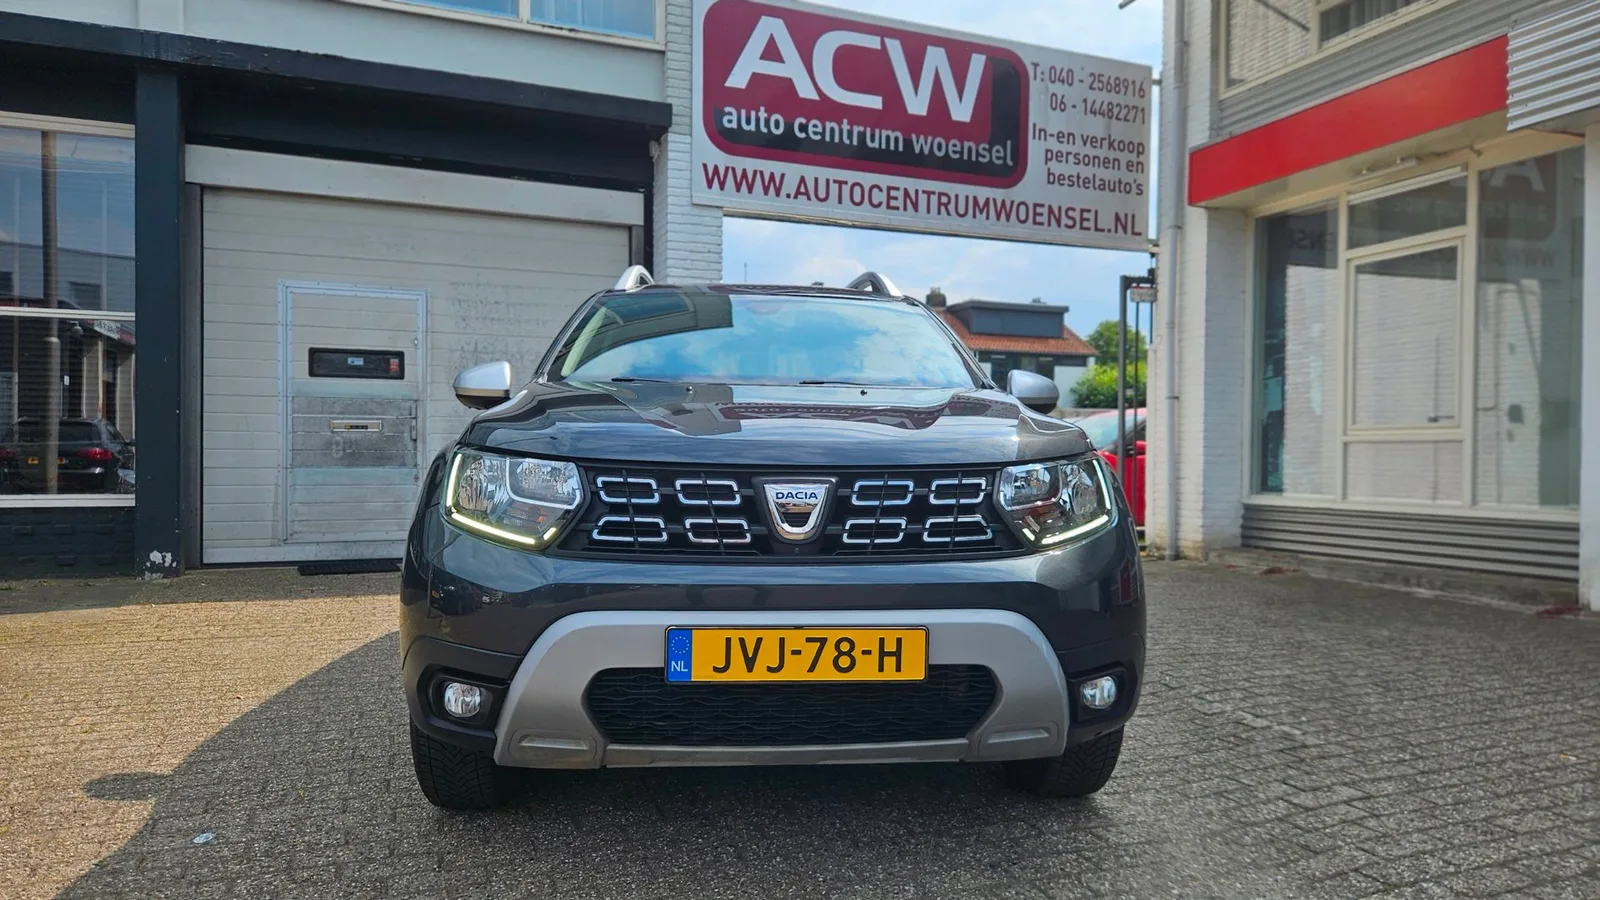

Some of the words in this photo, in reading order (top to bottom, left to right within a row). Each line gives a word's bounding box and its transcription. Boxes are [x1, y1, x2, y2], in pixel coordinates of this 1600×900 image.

[724, 15, 987, 123] ACW
[1031, 62, 1045, 82] T:
[1049, 65, 1074, 87] 040
[1088, 72, 1146, 99] 2568916
[1050, 92, 1067, 113] 06
[1082, 98, 1146, 125] 14482271
[722, 106, 785, 135] auto
[793, 117, 904, 152] centrum
[911, 132, 1014, 166] woensel
[1032, 122, 1076, 146] In-en
[1080, 133, 1145, 159] verkoop
[1044, 148, 1121, 171] personen
[1126, 158, 1145, 174] en
[702, 163, 1142, 236] WWW.AUTOCENTRUMWOENSEL.NL
[1047, 168, 1144, 196] bestelauto's
[775, 491, 818, 500] DACIA
[671, 660, 688, 672] NL
[712, 636, 903, 674] JVJ-78-H
